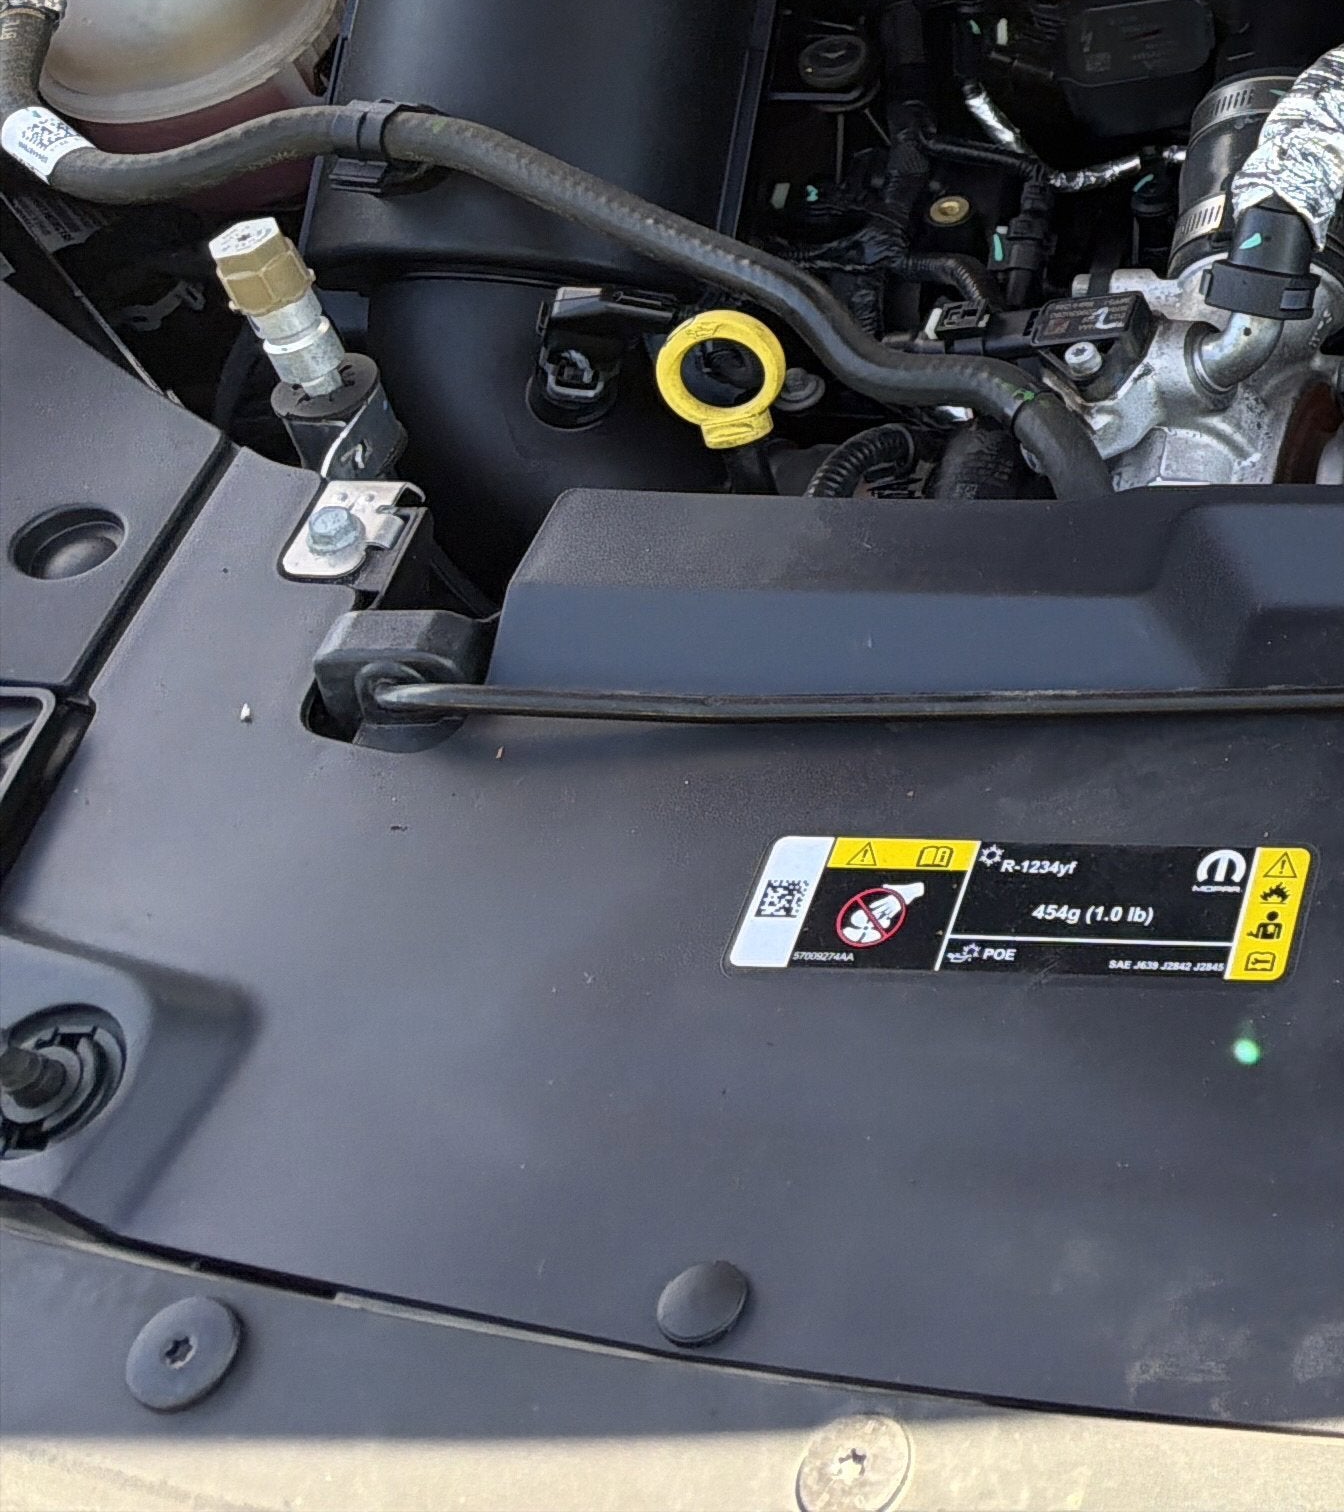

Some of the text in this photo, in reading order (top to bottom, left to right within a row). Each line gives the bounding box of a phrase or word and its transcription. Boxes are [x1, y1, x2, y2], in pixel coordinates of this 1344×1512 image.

[1001, 858, 1076, 878] R-1234yf
[1032, 904, 1154, 926] 454g (1.0 lb)
[982, 946, 1016, 963] POE
[1108, 959, 1132, 970] SAE
[1133, 960, 1159, 971] J639
[1193, 962, 1226, 973] J2845
